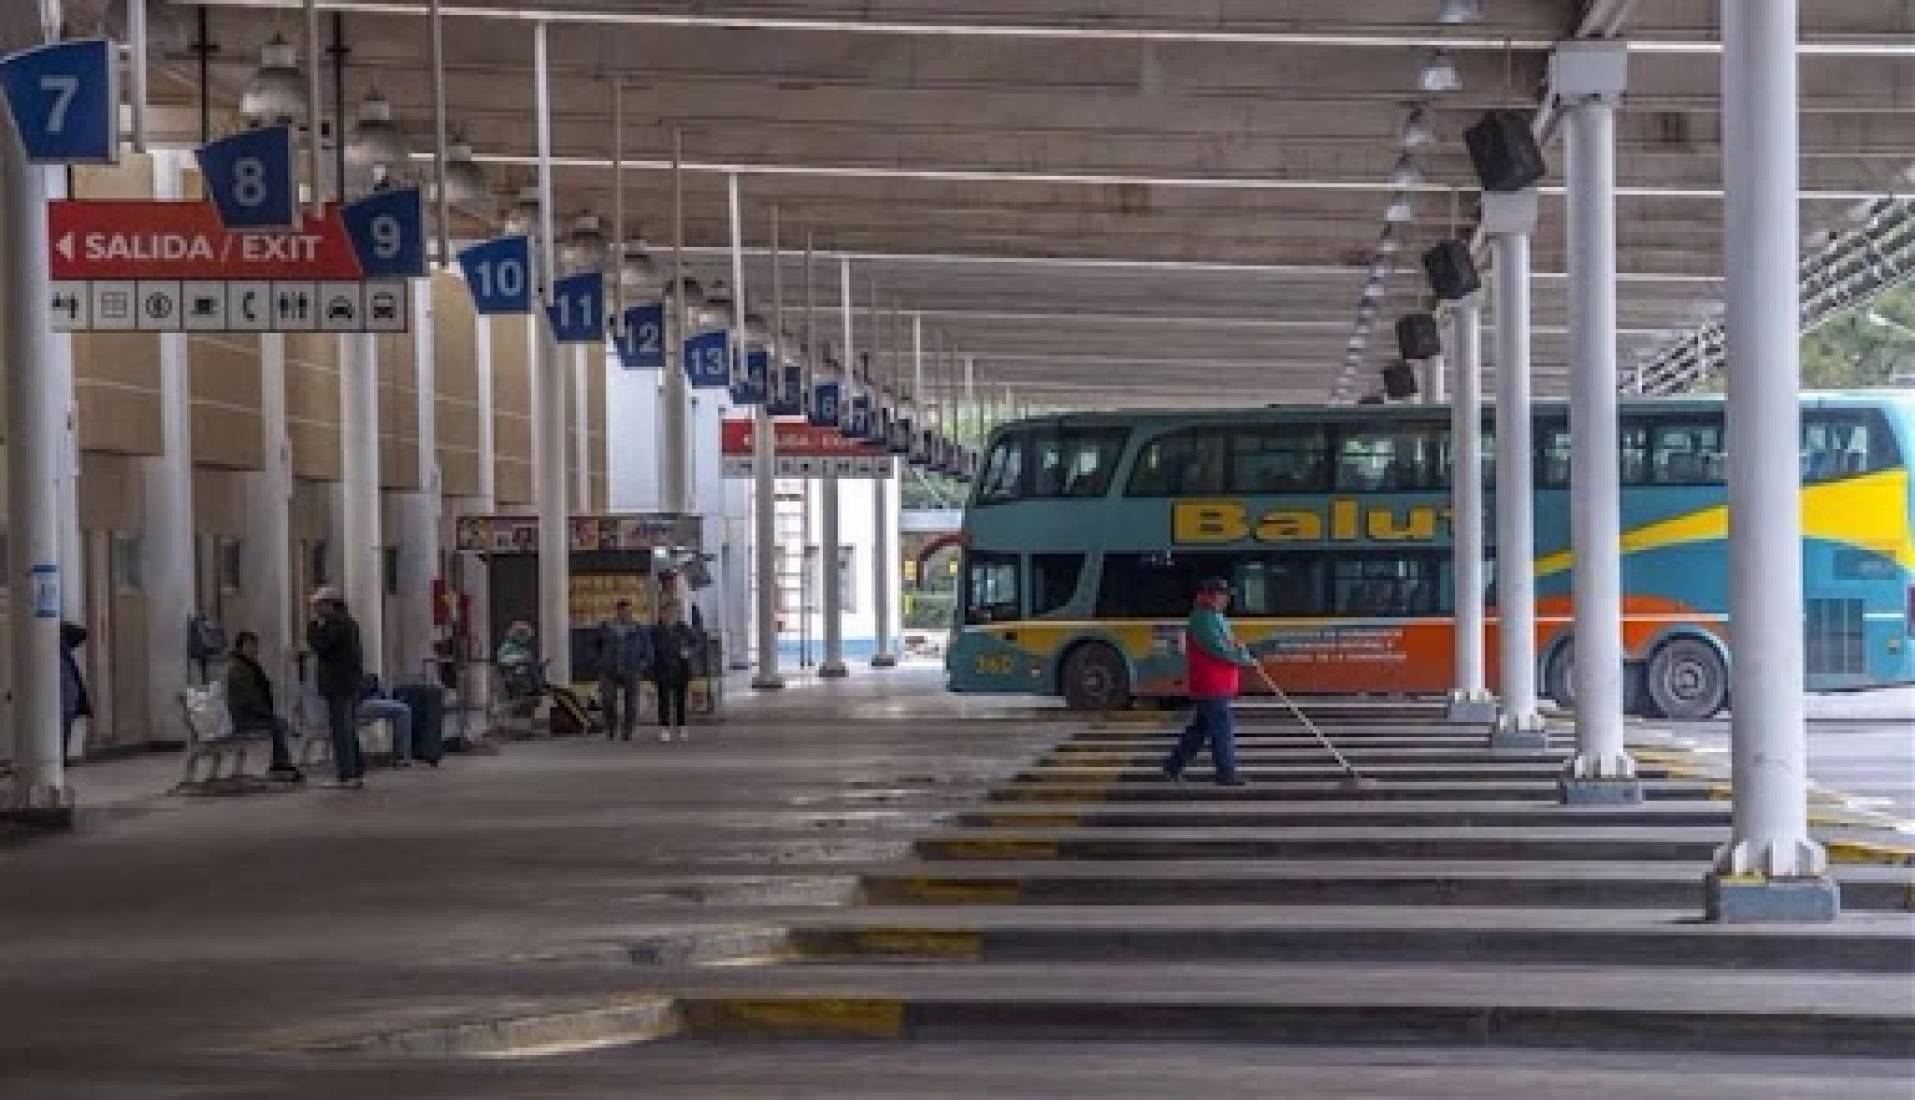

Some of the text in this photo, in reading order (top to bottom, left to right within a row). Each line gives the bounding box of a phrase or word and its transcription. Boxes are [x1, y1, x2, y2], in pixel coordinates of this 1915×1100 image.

[41, 76, 79, 133] 7
[234, 156, 266, 206] 8
[85, 235, 213, 262] SALIDA
[242, 235, 322, 262] EXIT
[373, 215, 398, 258] 9
[478, 261, 525, 297] 10
[559, 291, 593, 327] 11
[628, 324, 660, 354] 12
[691, 347, 723, 375] 13
[1172, 499, 1452, 544] Balu
